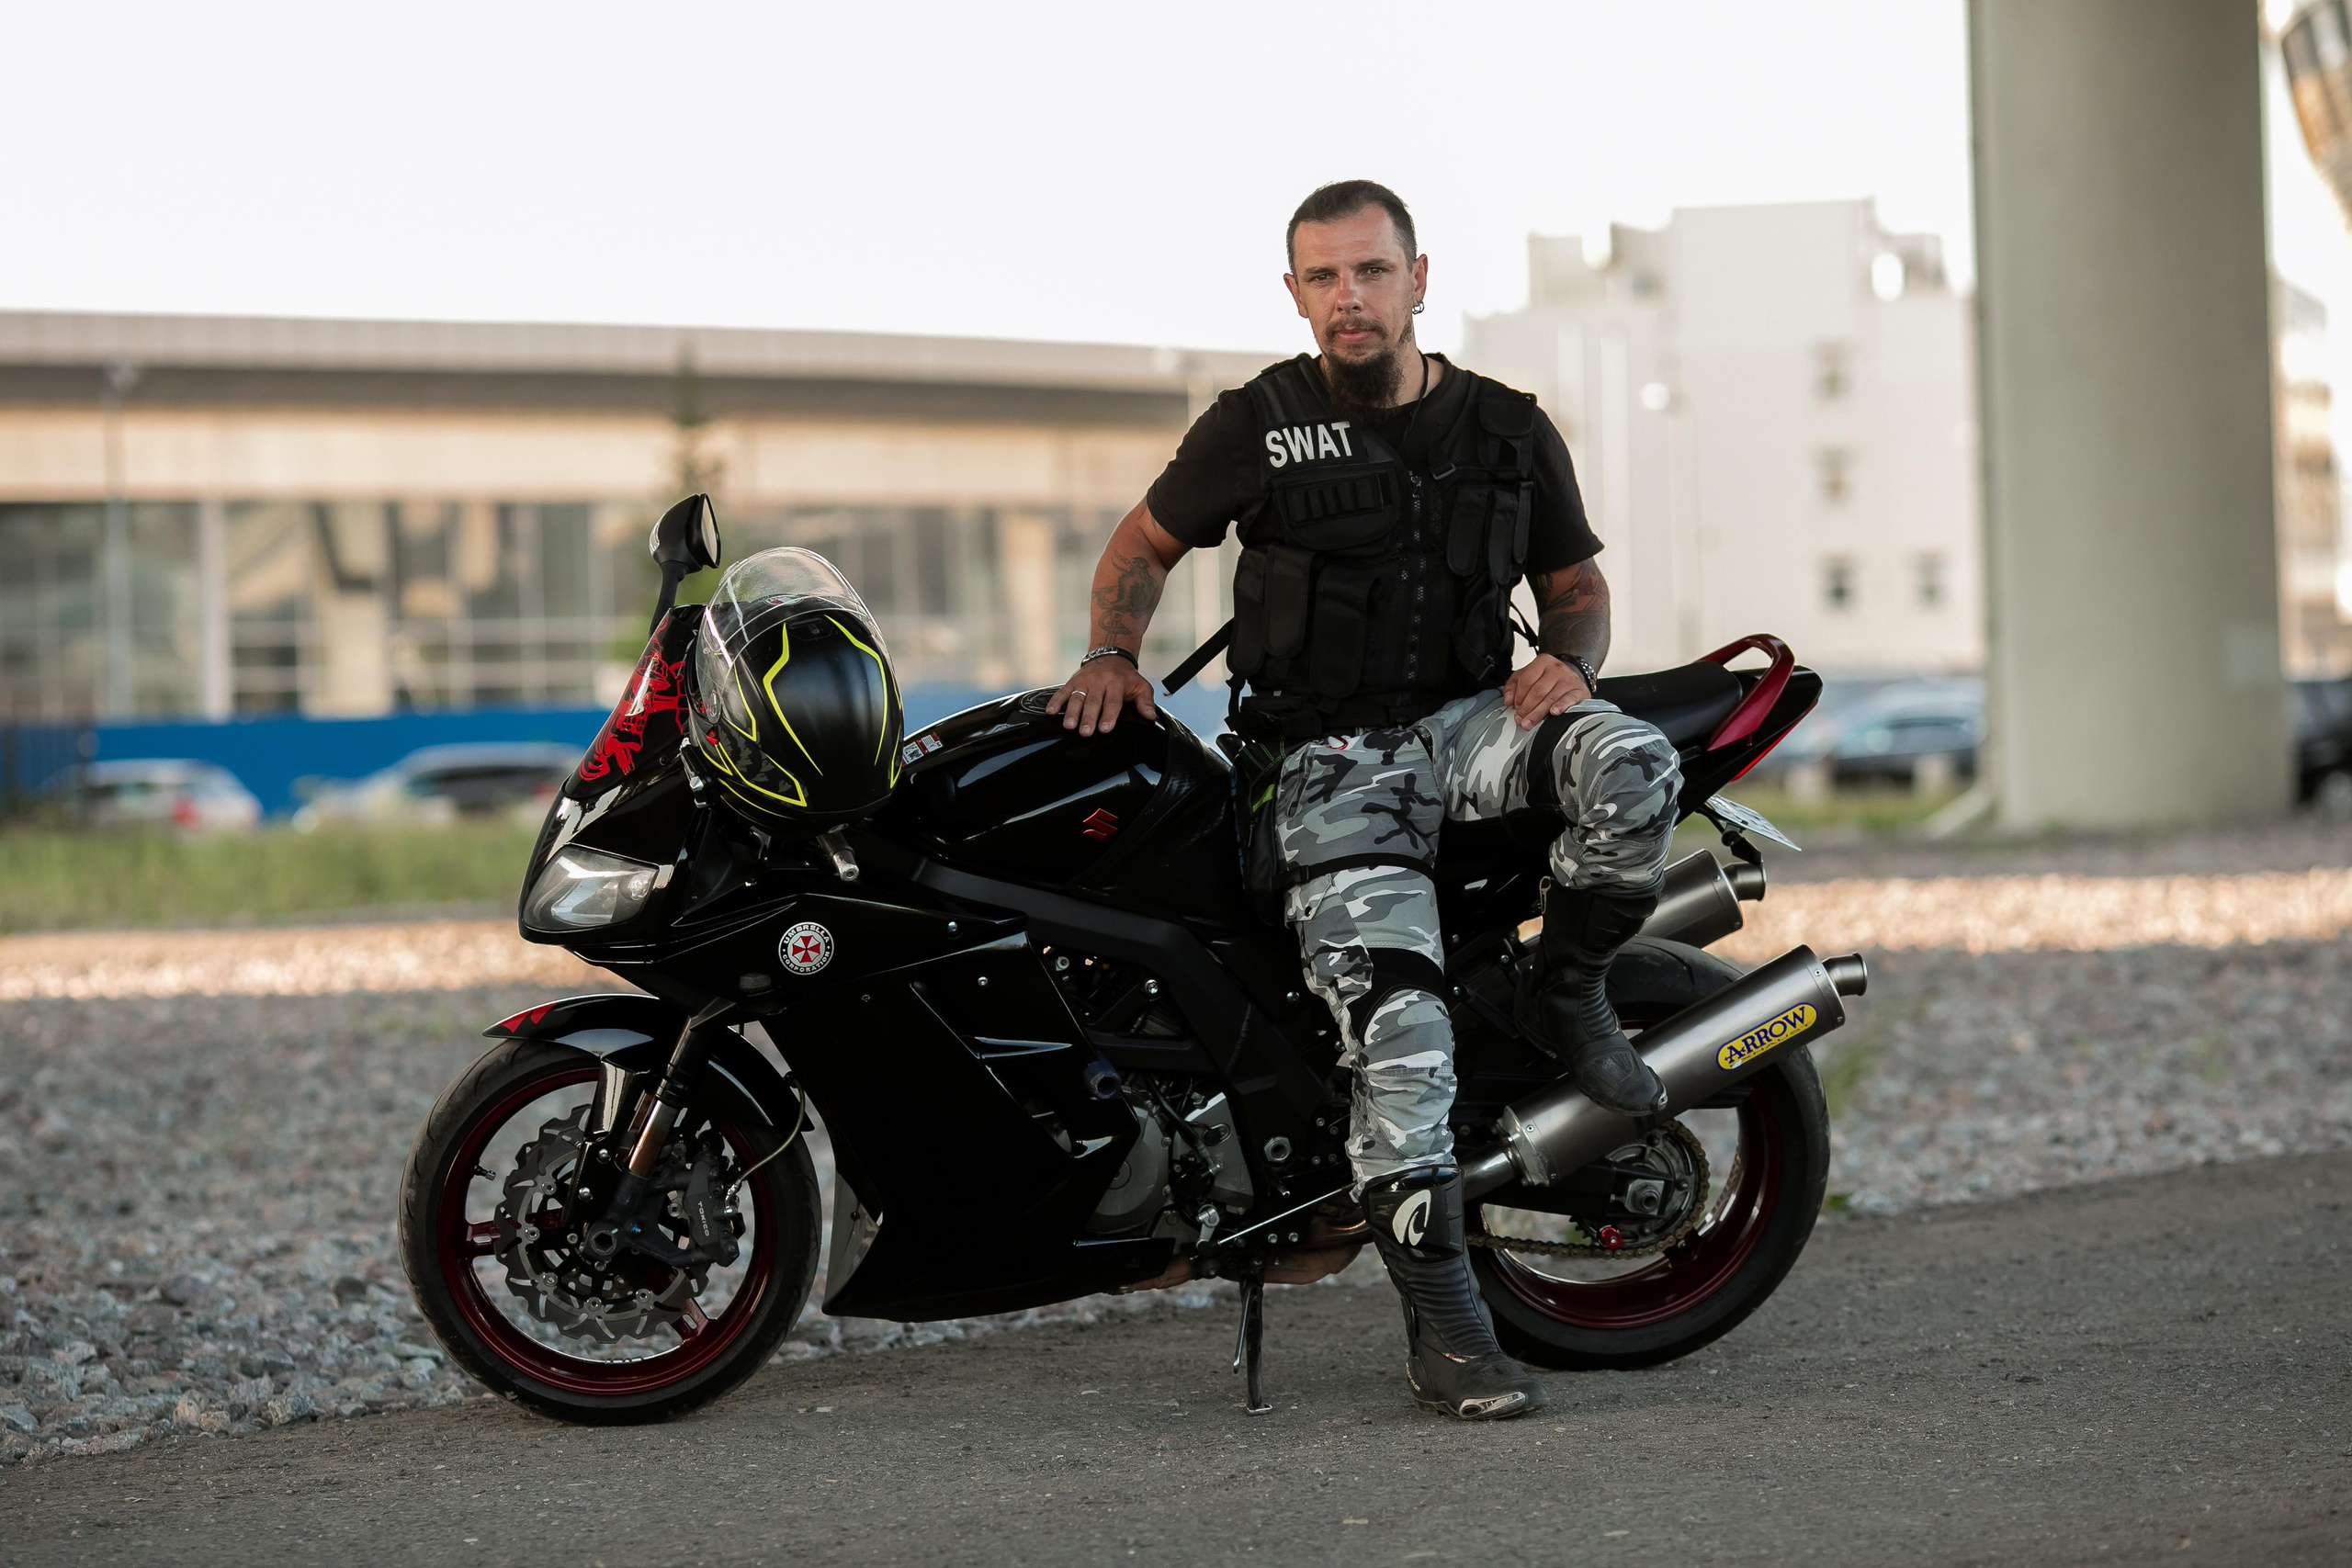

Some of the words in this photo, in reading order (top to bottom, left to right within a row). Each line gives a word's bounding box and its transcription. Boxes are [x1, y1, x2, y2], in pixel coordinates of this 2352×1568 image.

[1265, 421, 1352, 468] SWAT
[784, 924, 830, 944] UMBRELLA
[783, 952, 830, 973] CORPORATION
[1724, 1006, 1805, 1064] ARROW
[698, 1201, 709, 1236] TOKICO
